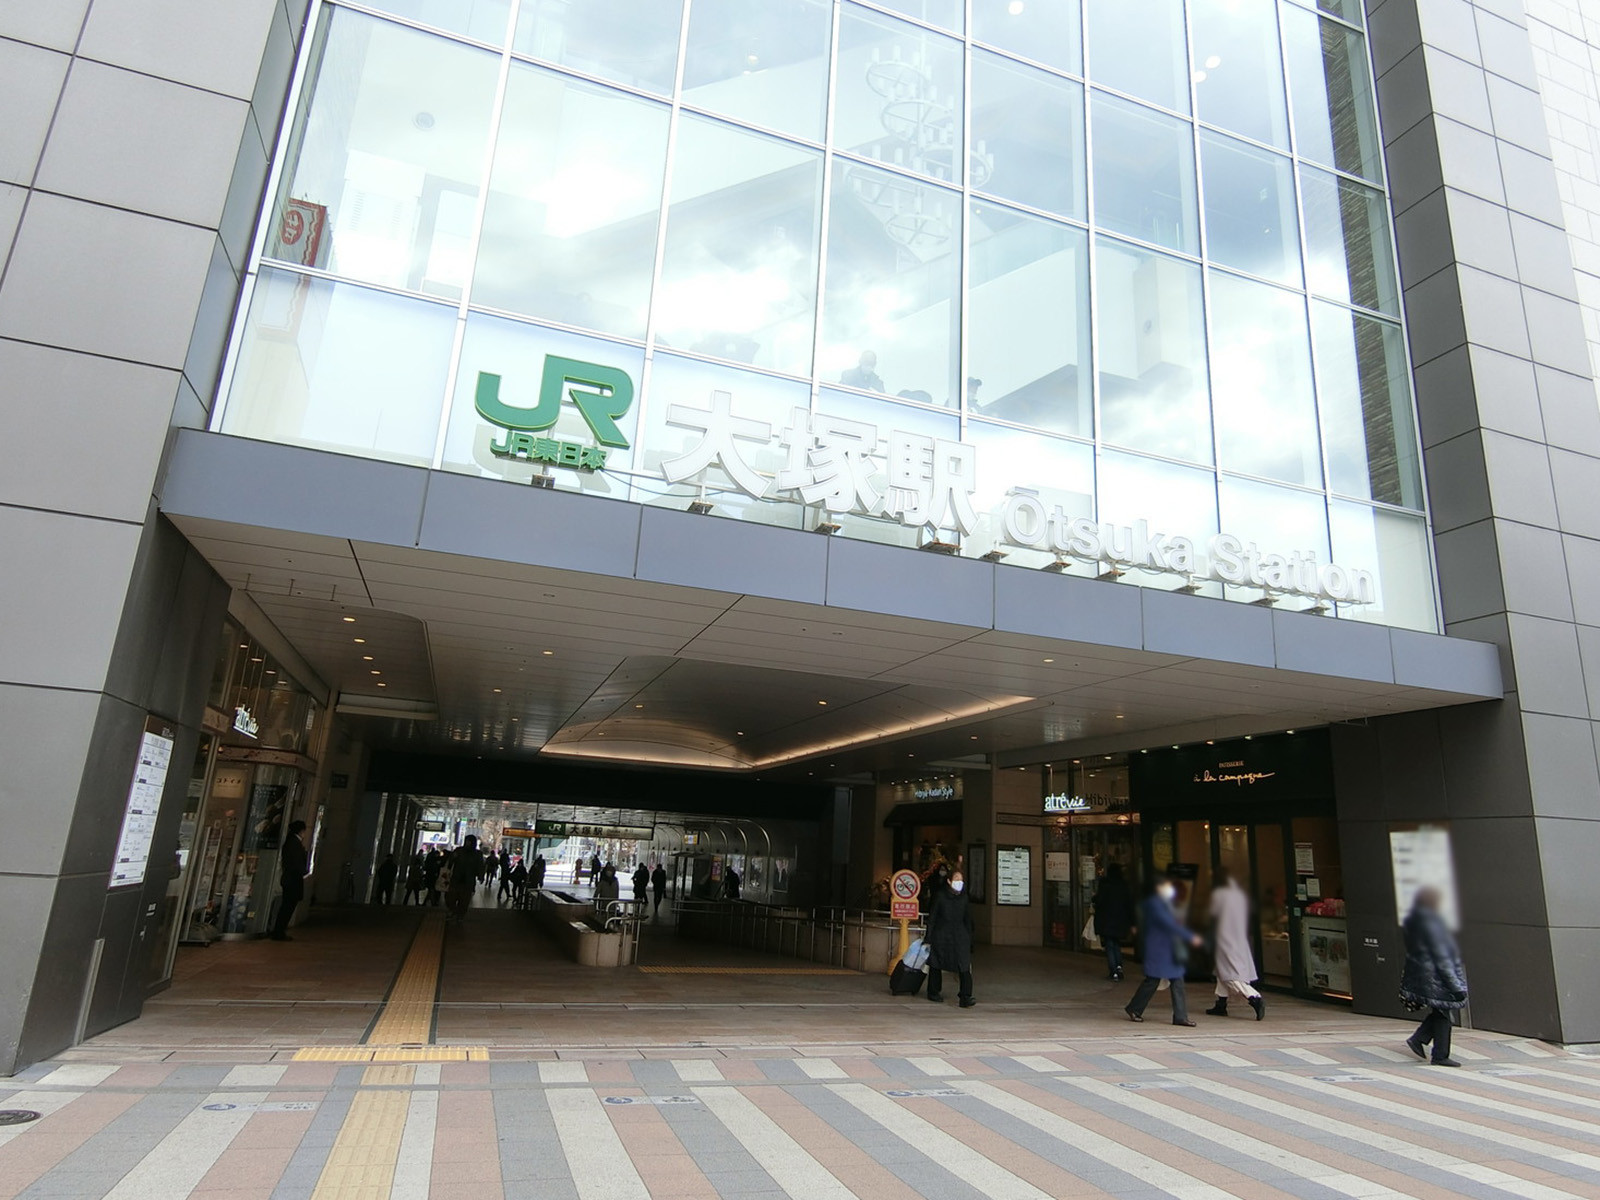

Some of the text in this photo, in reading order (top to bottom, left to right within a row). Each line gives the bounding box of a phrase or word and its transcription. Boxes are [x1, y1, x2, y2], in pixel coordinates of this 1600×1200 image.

[475, 354, 634, 449] JR
[489, 430, 607, 471] JR東日本
[660, 389, 980, 537] 大塚駅
[1209, 533, 1376, 604] Station
[548, 823, 562, 832] JR
[569, 825, 604, 836] 大塚駅
